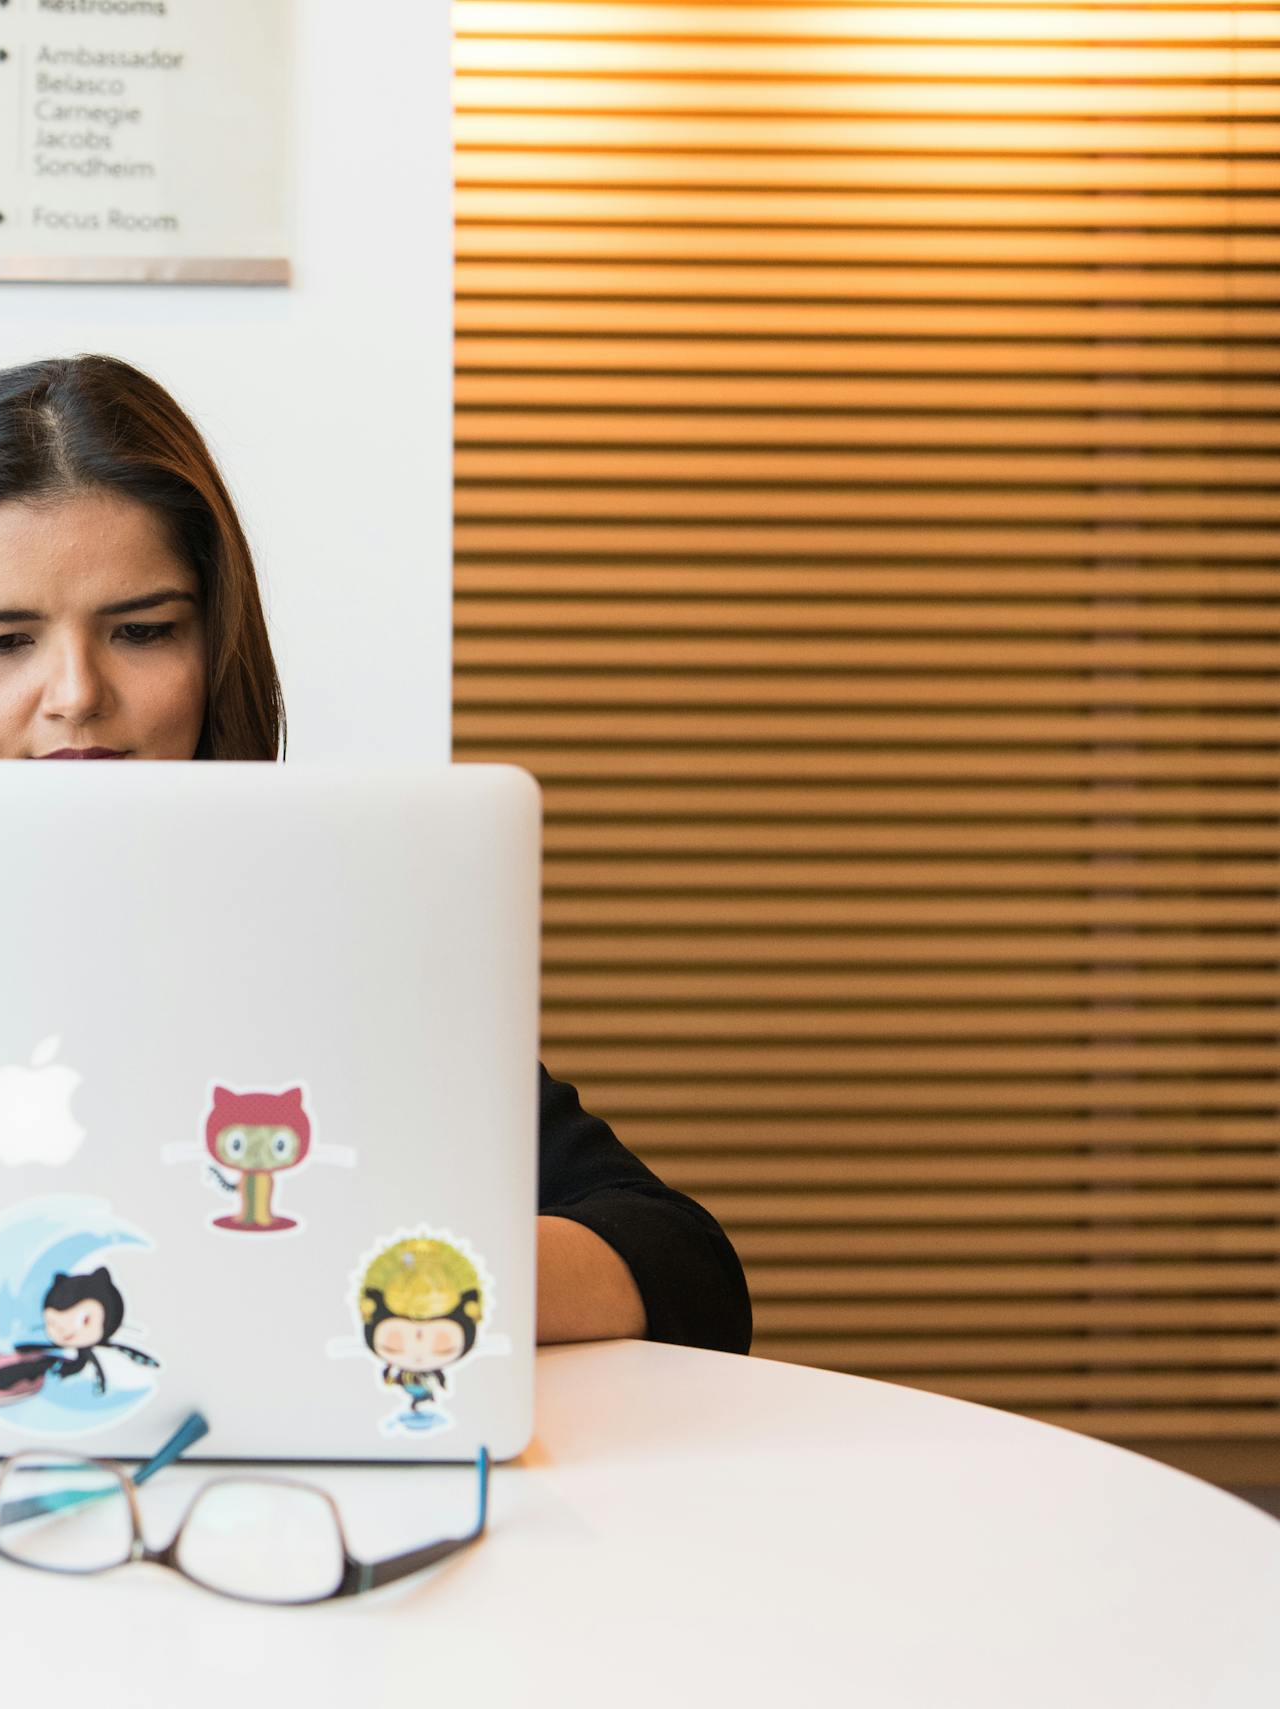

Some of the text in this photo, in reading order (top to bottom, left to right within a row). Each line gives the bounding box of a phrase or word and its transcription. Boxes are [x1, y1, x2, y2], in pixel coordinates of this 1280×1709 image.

[36, 46, 184, 69] Ambassador
[35, 72, 125, 95] Belasco
[34, 100, 141, 128] Carnegie
[35, 129, 113, 150] Jacobs
[34, 155, 155, 178] Sondheim
[33, 207, 179, 231] Focus Room
